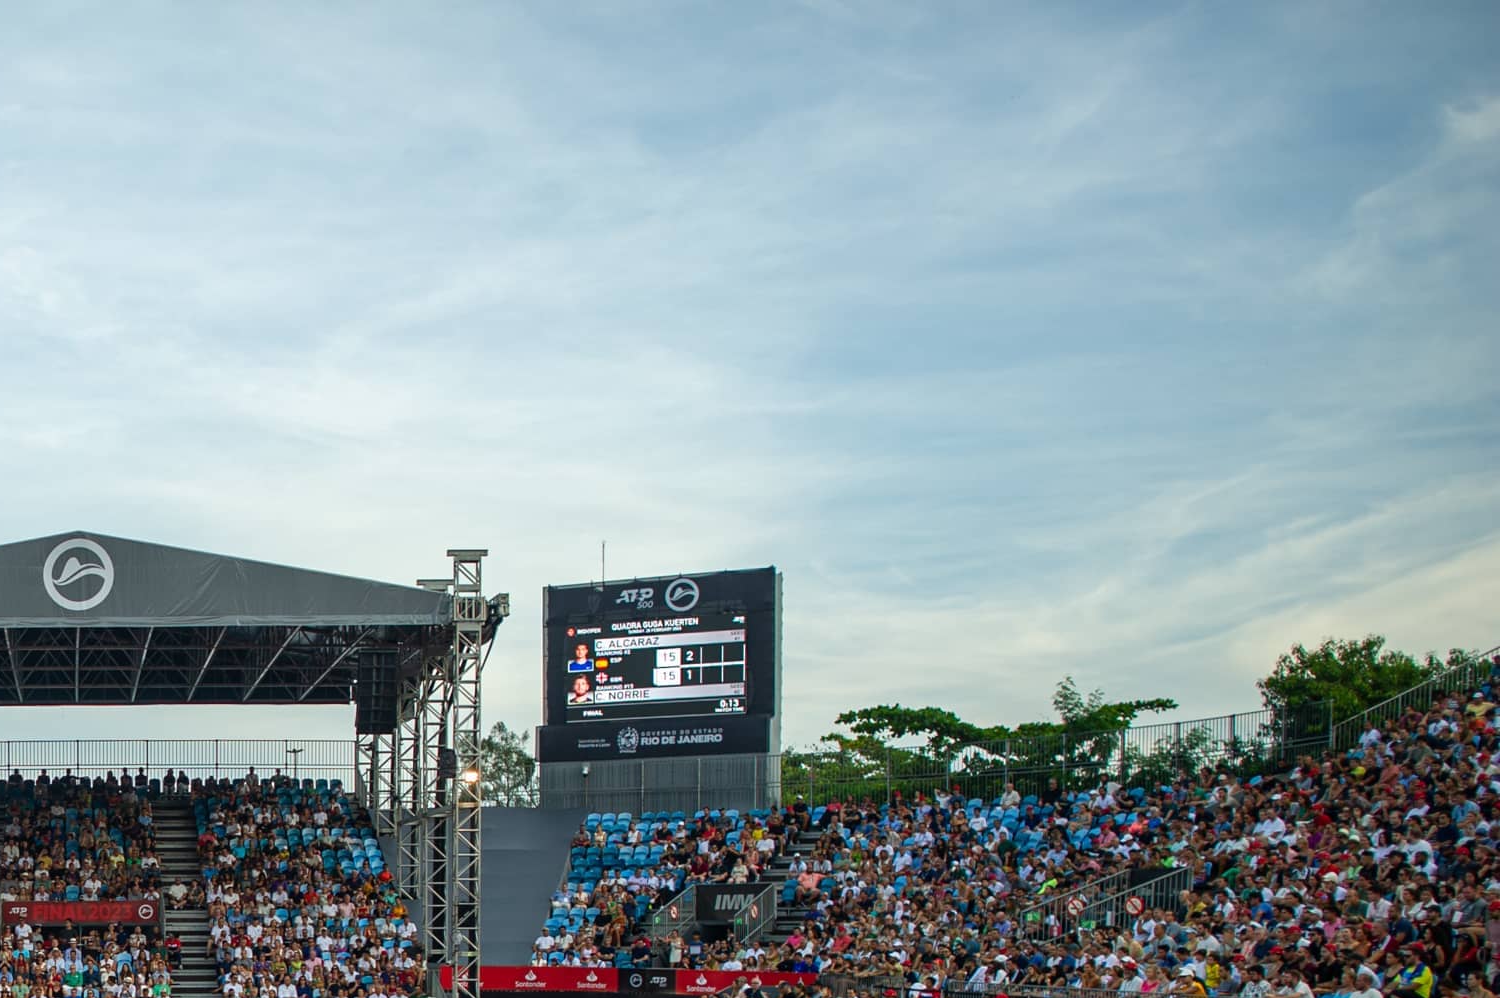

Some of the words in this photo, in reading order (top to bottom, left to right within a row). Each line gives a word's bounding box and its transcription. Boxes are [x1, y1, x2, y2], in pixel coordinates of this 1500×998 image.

[615, 587, 655, 604] ATP
[611, 621, 642, 632] QUADRA
[642, 619, 663, 629] GUGA
[664, 617, 699, 628] KUERTEN
[608, 637, 660, 649] ALCARAZ
[663, 652, 676, 663] 15
[686, 651, 694, 662] 2
[662, 671, 676, 681] 15
[686, 670, 692, 680] 1
[608, 690, 650, 701] NORRIE
[641, 735, 659, 746] RIO
[661, 735, 676, 745] DE
[677, 734, 723, 744] JANEIRO
